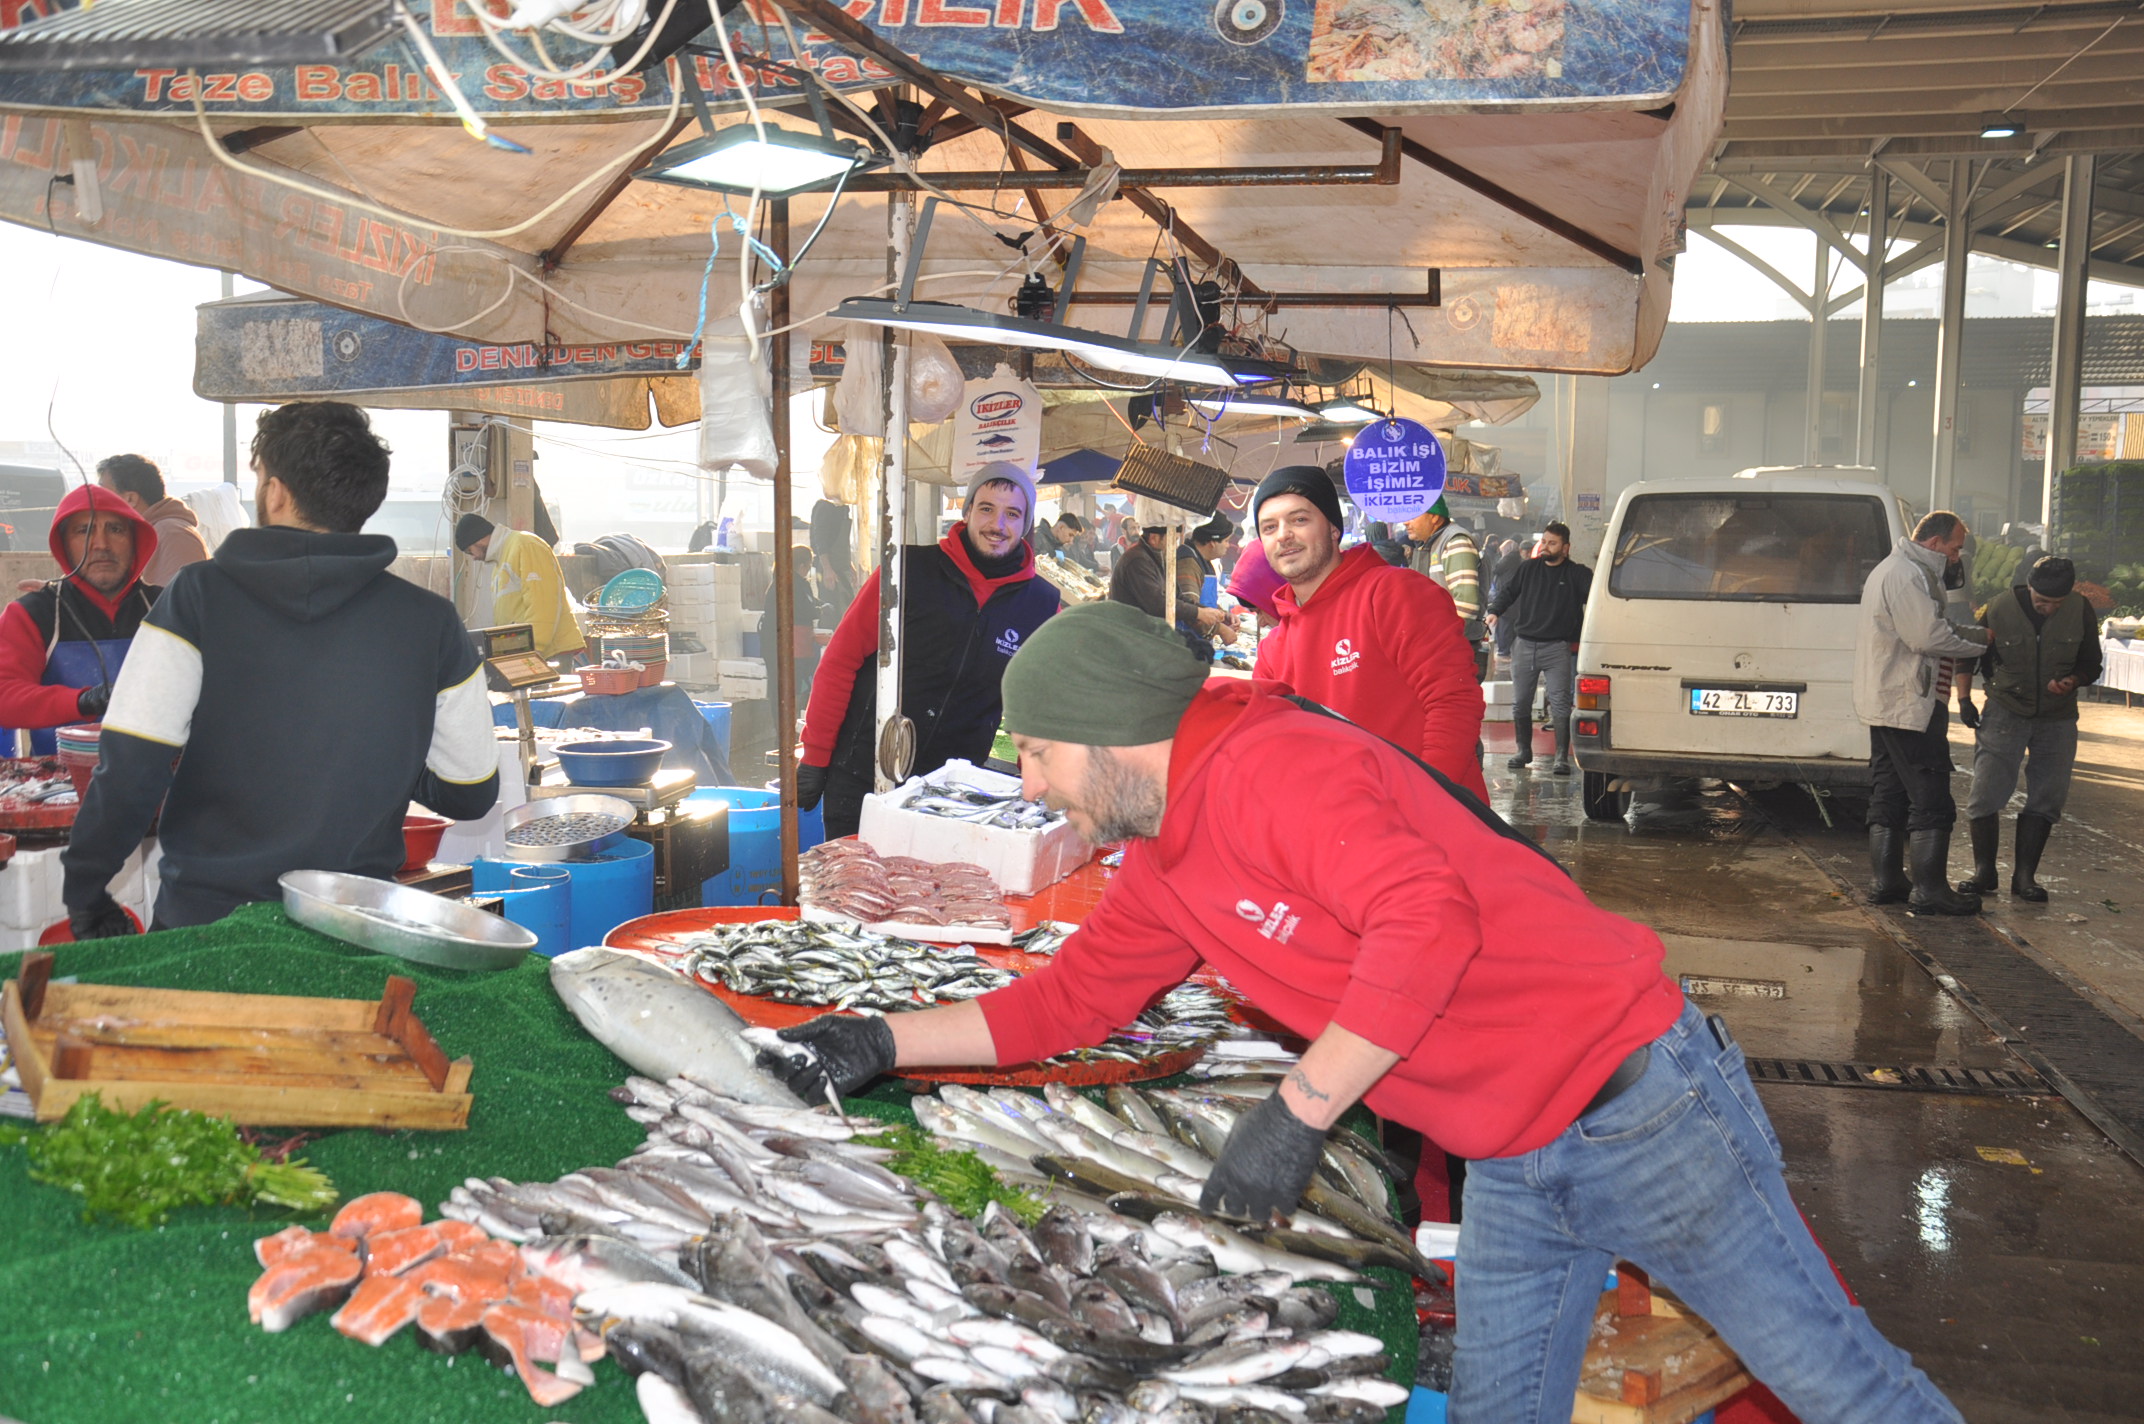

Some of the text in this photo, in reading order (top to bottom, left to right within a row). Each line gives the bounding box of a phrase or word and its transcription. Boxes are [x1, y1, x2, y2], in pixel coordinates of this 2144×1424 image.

[135, 67, 274, 102] Taze
[1945, 417, 1952, 429] 3
[1353, 442, 1436, 459] BALIK İŞİ
[1370, 458, 1420, 474] BİZİM
[1368, 474, 1424, 491] İŞİMİZ
[1365, 494, 1424, 507] İKİZLER
[1703, 692, 1793, 712] 42 ZL 733
